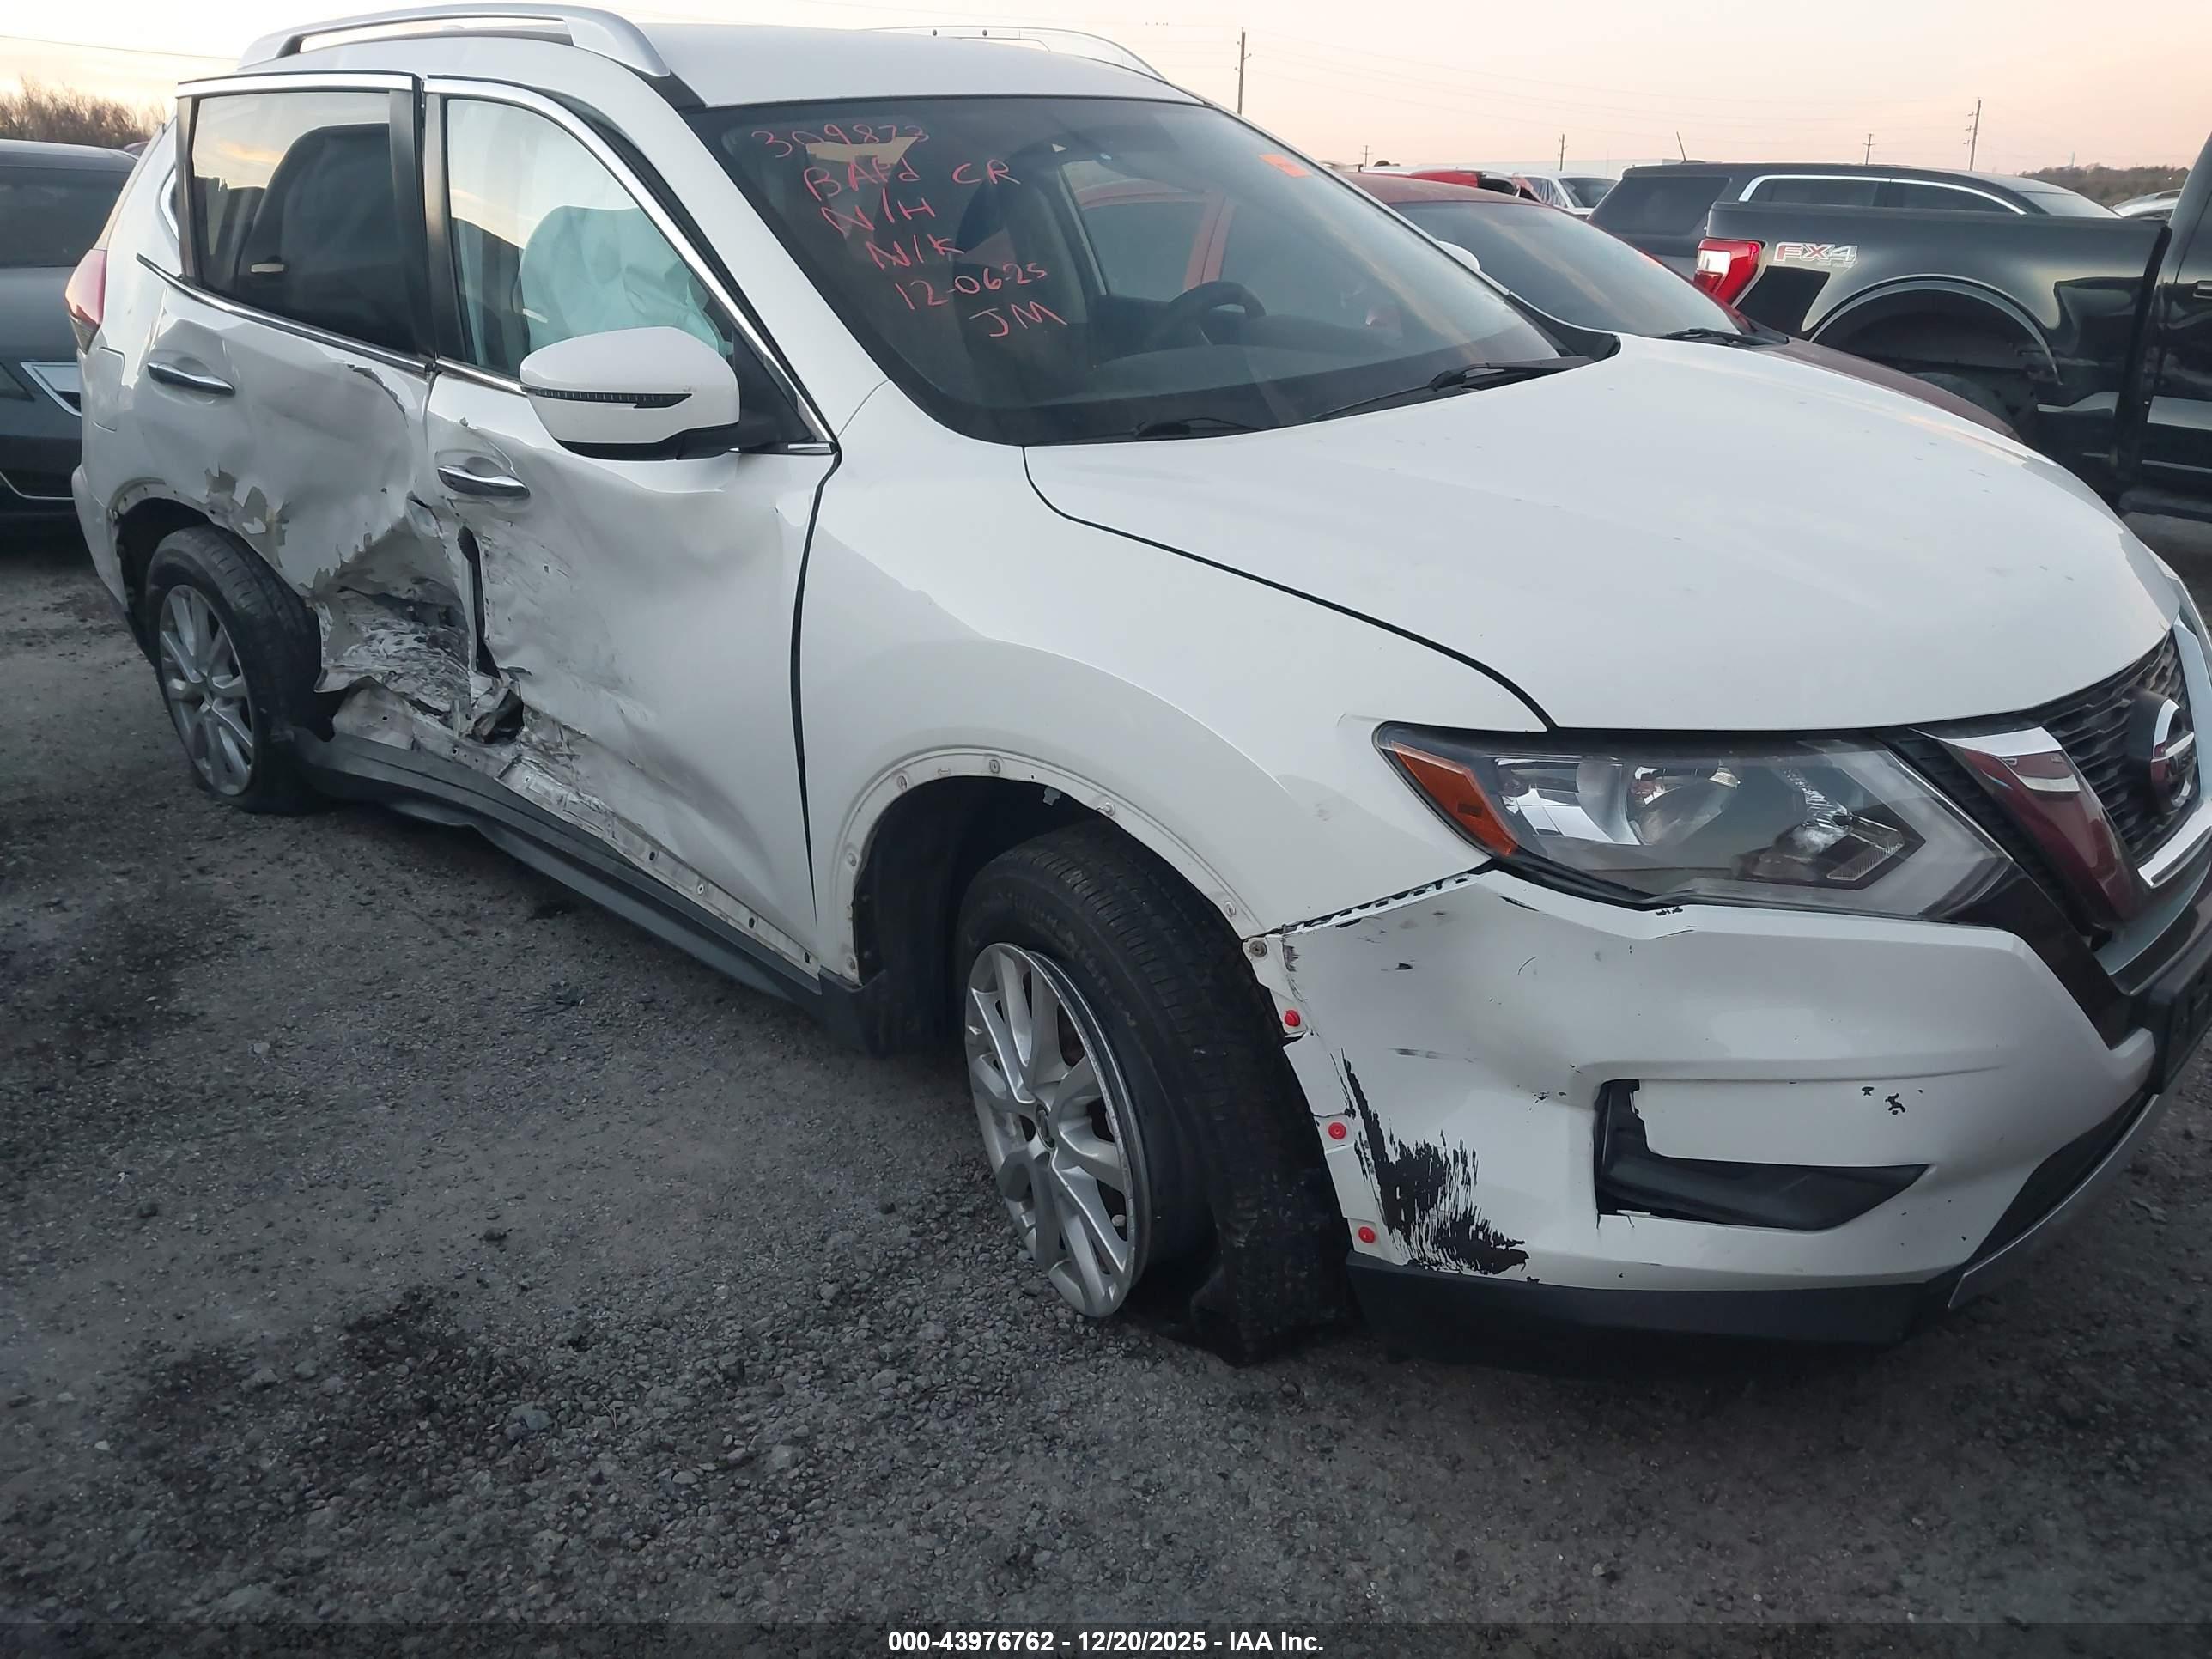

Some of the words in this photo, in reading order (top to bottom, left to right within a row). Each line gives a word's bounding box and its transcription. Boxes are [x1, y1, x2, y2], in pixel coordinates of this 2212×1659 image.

[951, 159, 1021, 185] CR
[1773, 241, 1858, 263] FX4
[968, 301, 1069, 338] JM
